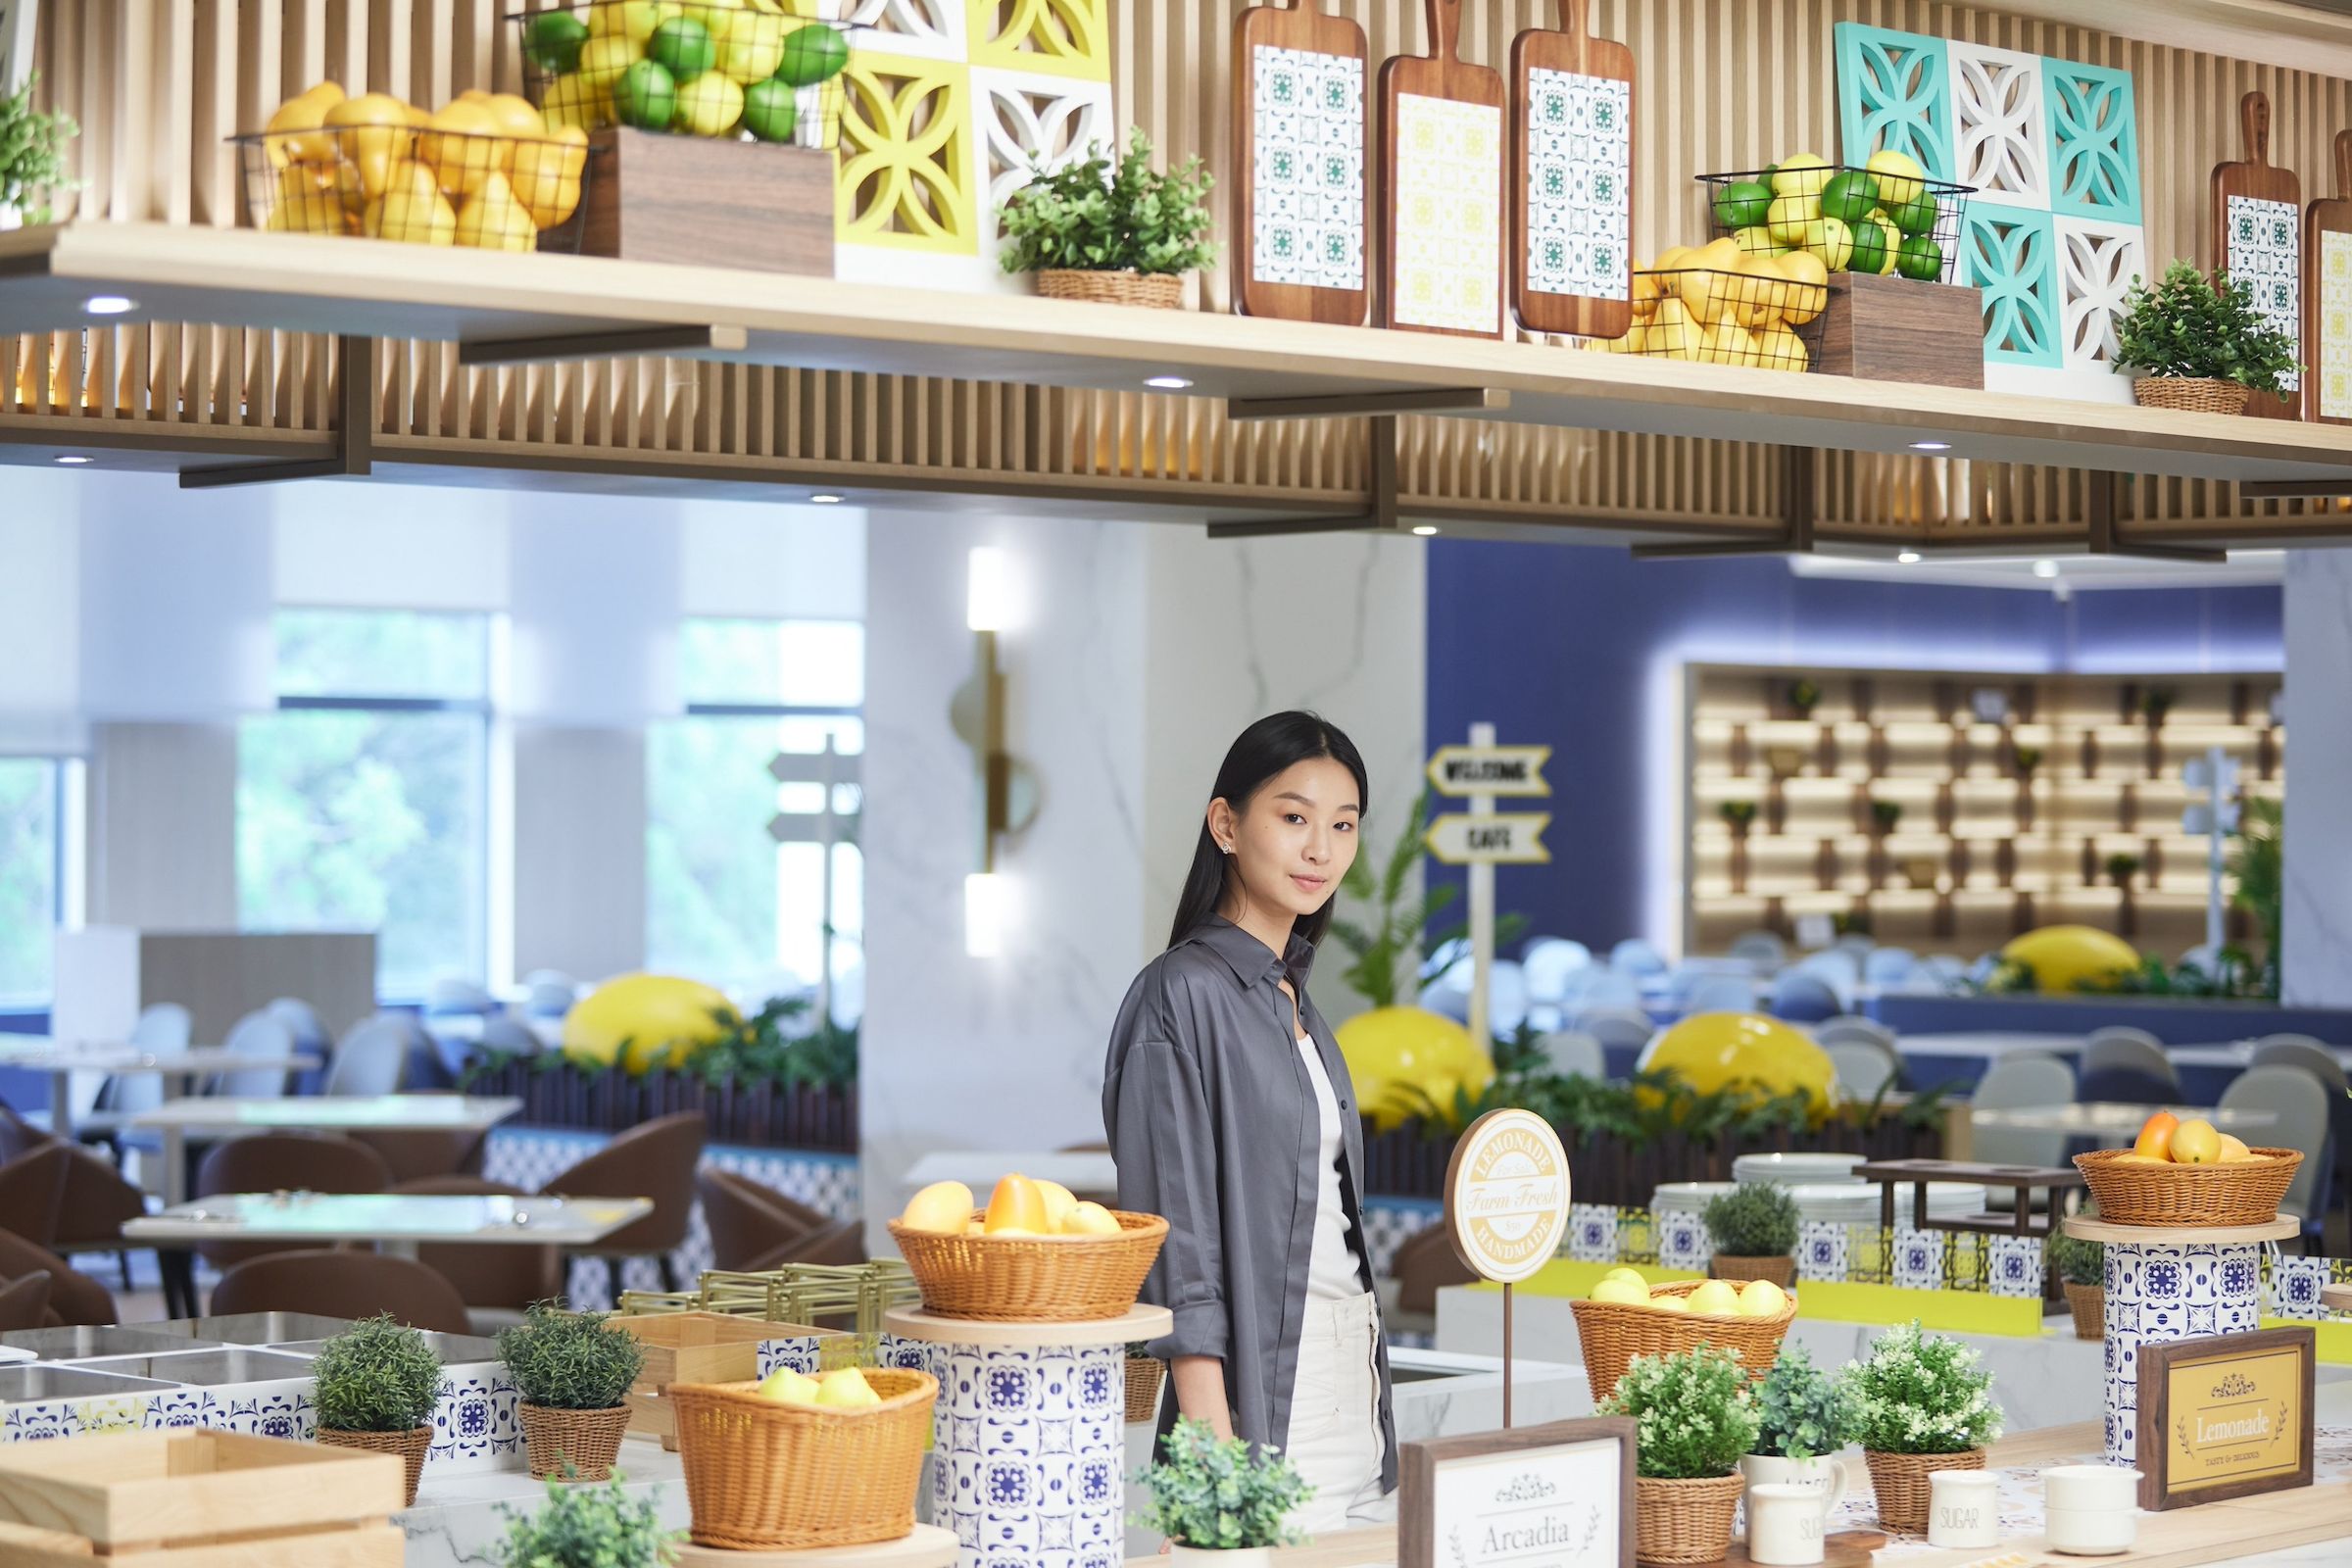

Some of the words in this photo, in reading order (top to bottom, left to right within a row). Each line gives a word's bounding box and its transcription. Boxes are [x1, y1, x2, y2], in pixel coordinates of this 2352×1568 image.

[1476, 1131, 1550, 1175] LEMONADE
[1466, 1187, 1510, 1211] Farm
[1514, 1182, 1557, 1207] Fresh
[1477, 1218, 1550, 1259] HANDMADE
[2196, 1408, 2270, 1444] Lemonade
[1481, 1516, 1569, 1554] Arcadia
[1940, 1506, 1980, 1529] SUGAR
